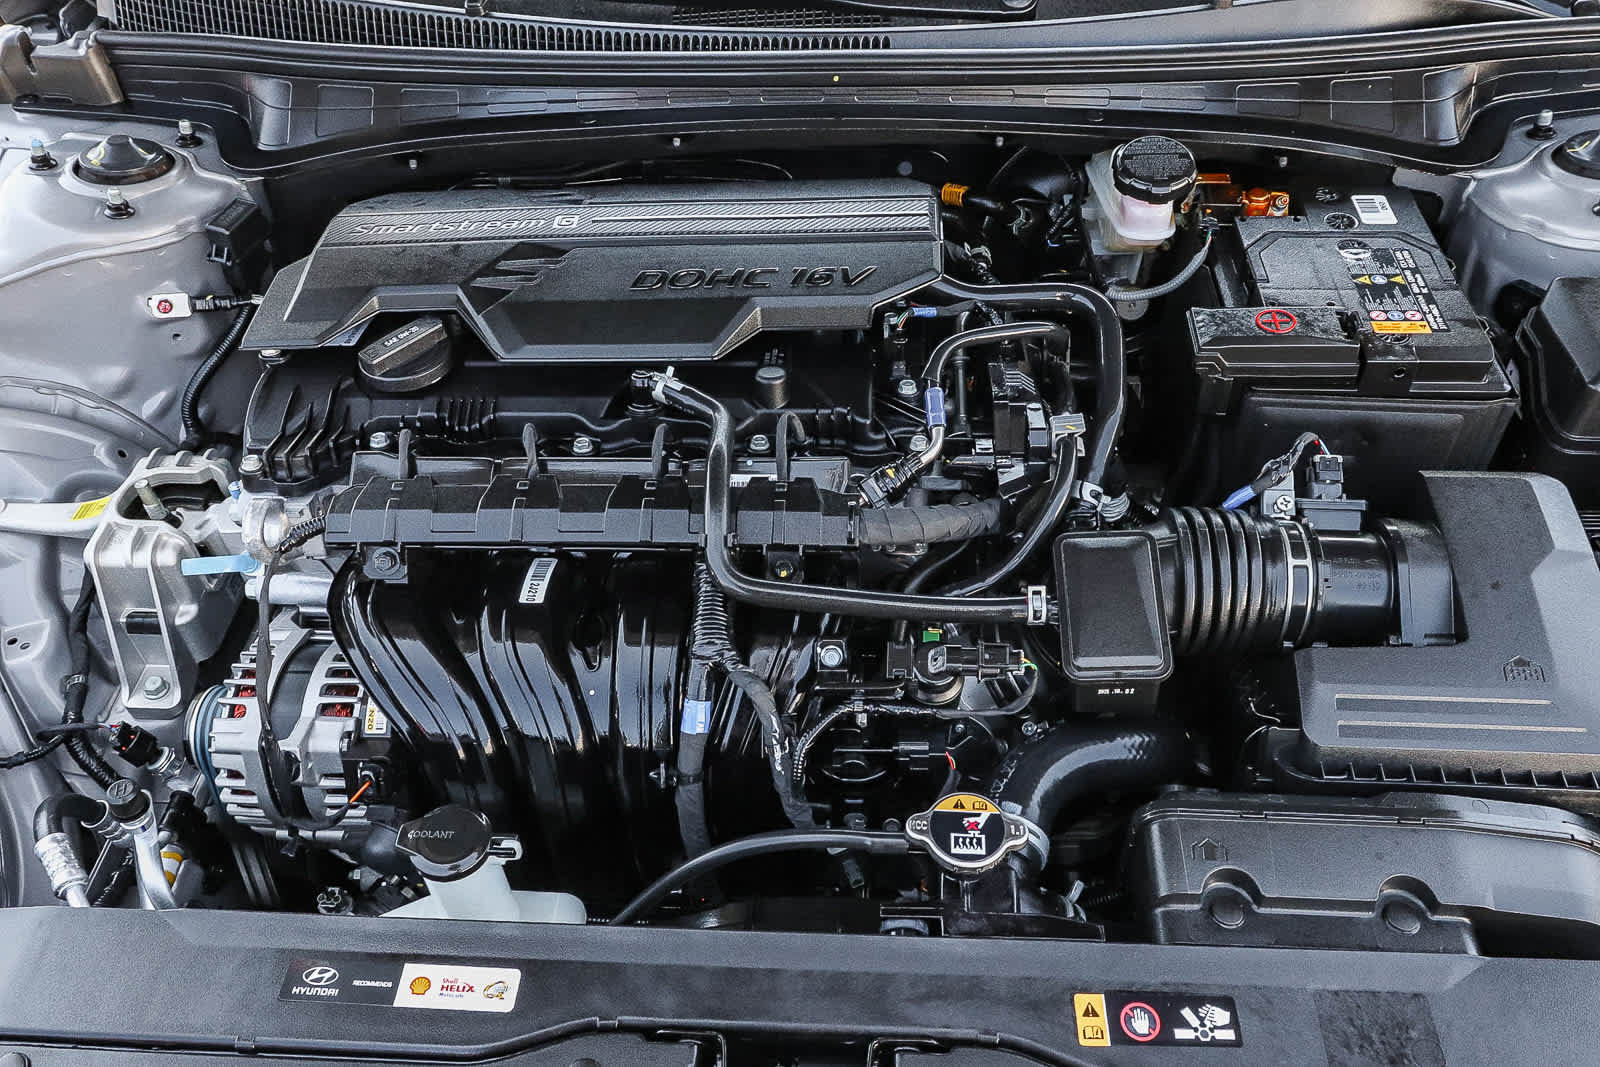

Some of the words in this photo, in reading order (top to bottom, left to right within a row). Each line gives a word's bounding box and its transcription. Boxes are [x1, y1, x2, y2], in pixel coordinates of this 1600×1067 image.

[352, 218, 546, 236] Smartstream
[629, 266, 779, 290] DOHC
[789, 265, 878, 288] 16V
[526, 582, 540, 602] 2J210
[367, 709, 375, 731] N20
[407, 829, 456, 841] COOLANT
[291, 986, 339, 997] HYUNDAI
[440, 982, 475, 993] HELIX
